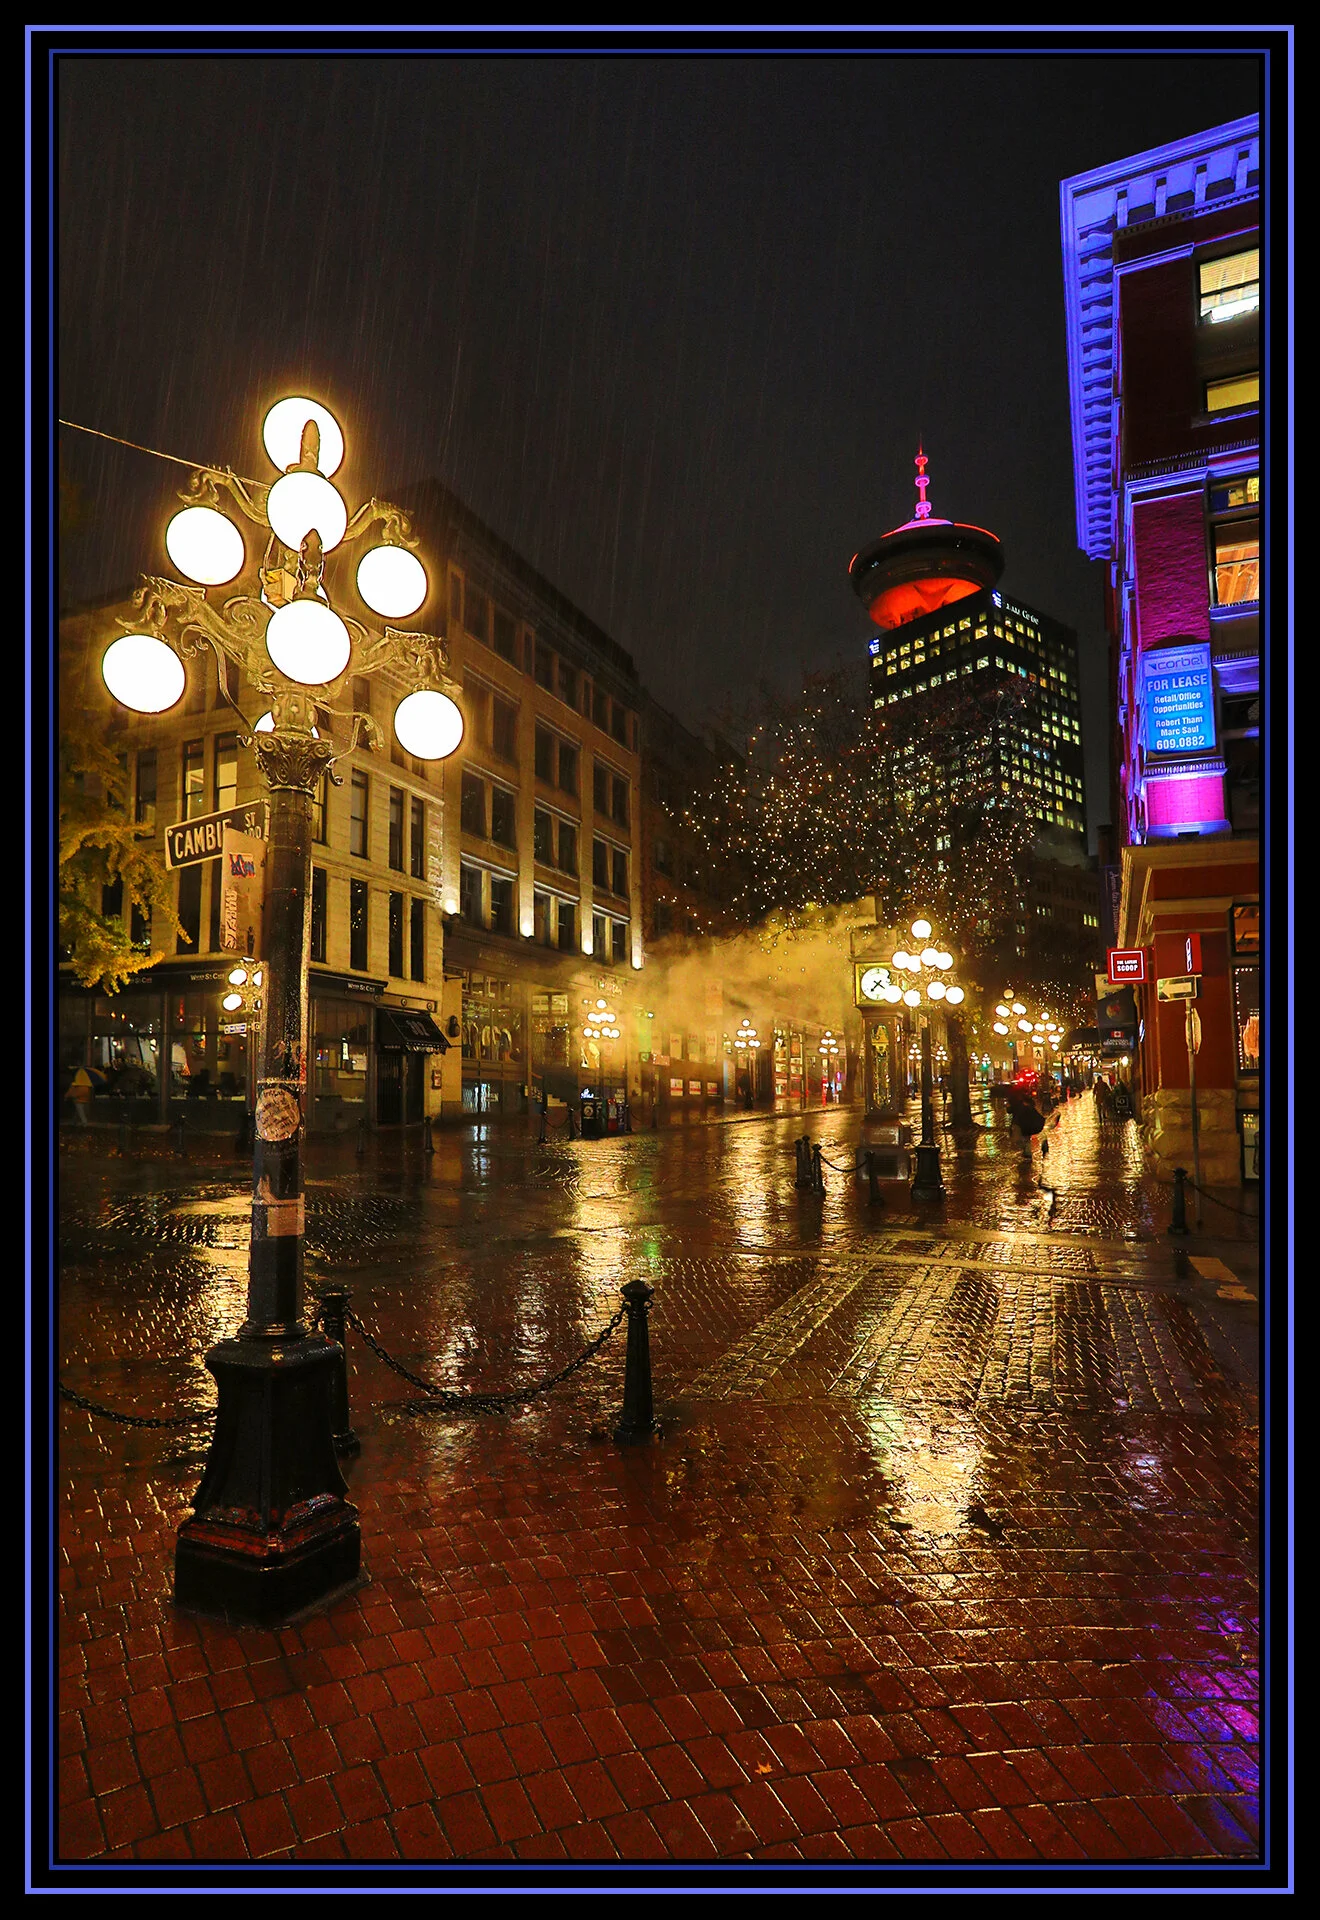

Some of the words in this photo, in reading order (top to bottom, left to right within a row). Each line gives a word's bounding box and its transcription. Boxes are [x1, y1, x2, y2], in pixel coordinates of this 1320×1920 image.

[1157, 655, 1203, 670] corbel
[1147, 679, 1168, 691] FOR
[1172, 674, 1207, 688] LEASE
[1154, 692, 1201, 703] Retail/Office
[1153, 702, 1203, 713] Opportunities
[1155, 717, 1181, 728] Robert
[1182, 715, 1203, 725] Tham
[1160, 727, 1181, 736] Marc
[1182, 725, 1199, 735] Saul
[1156, 735, 1205, 750] 609.0882
[244, 811, 256, 828] ST
[1116, 964, 1138, 972] SCOOP
